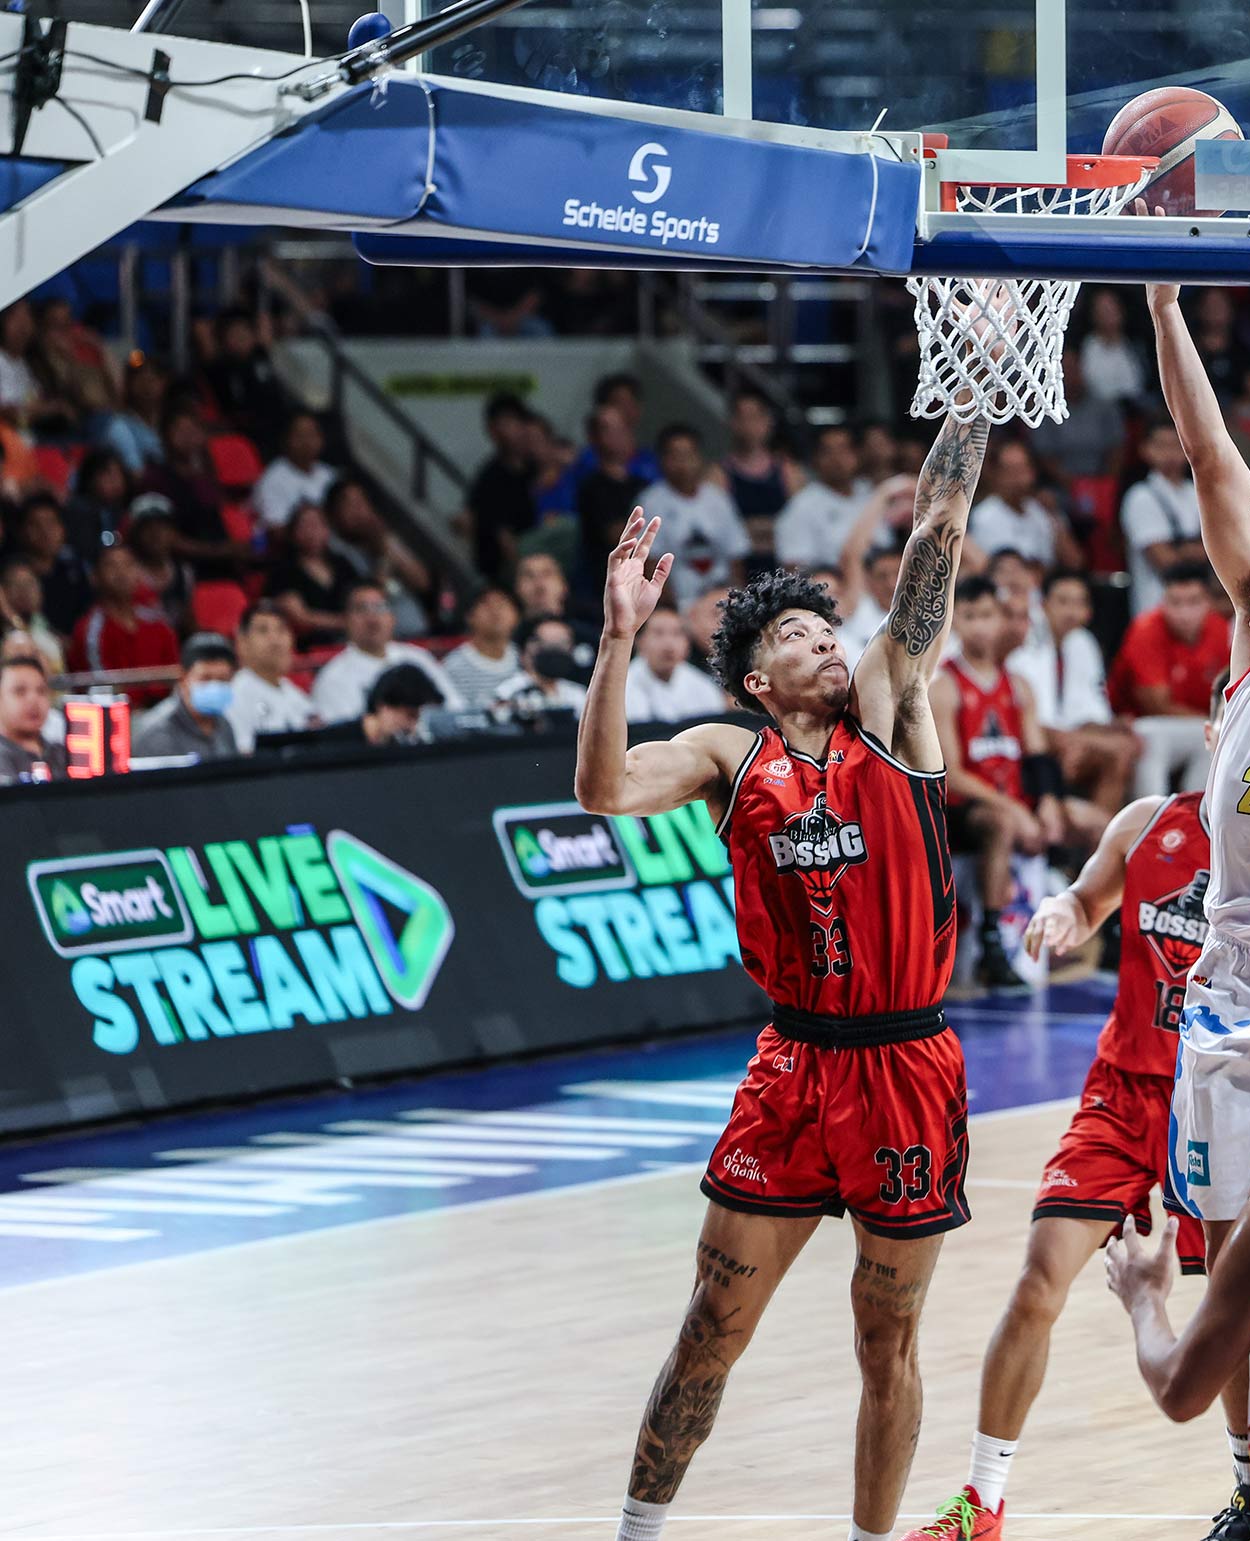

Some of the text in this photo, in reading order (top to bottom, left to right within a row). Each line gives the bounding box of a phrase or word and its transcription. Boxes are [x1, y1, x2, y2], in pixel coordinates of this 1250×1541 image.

[563, 198, 721, 246] Schelde Sports
[536, 799, 733, 886] Smart LIV
[80, 833, 354, 940] Smart LIVE
[534, 875, 744, 990] STREA
[809, 915, 855, 979] 33
[1138, 901, 1211, 944] BOSSI
[70, 923, 395, 1056] STREAM
[1151, 978, 1188, 1034] 18
[723, 1154, 768, 1184] Organics
[732, 1148, 760, 1168] Ever
[873, 1143, 933, 1206] 33
